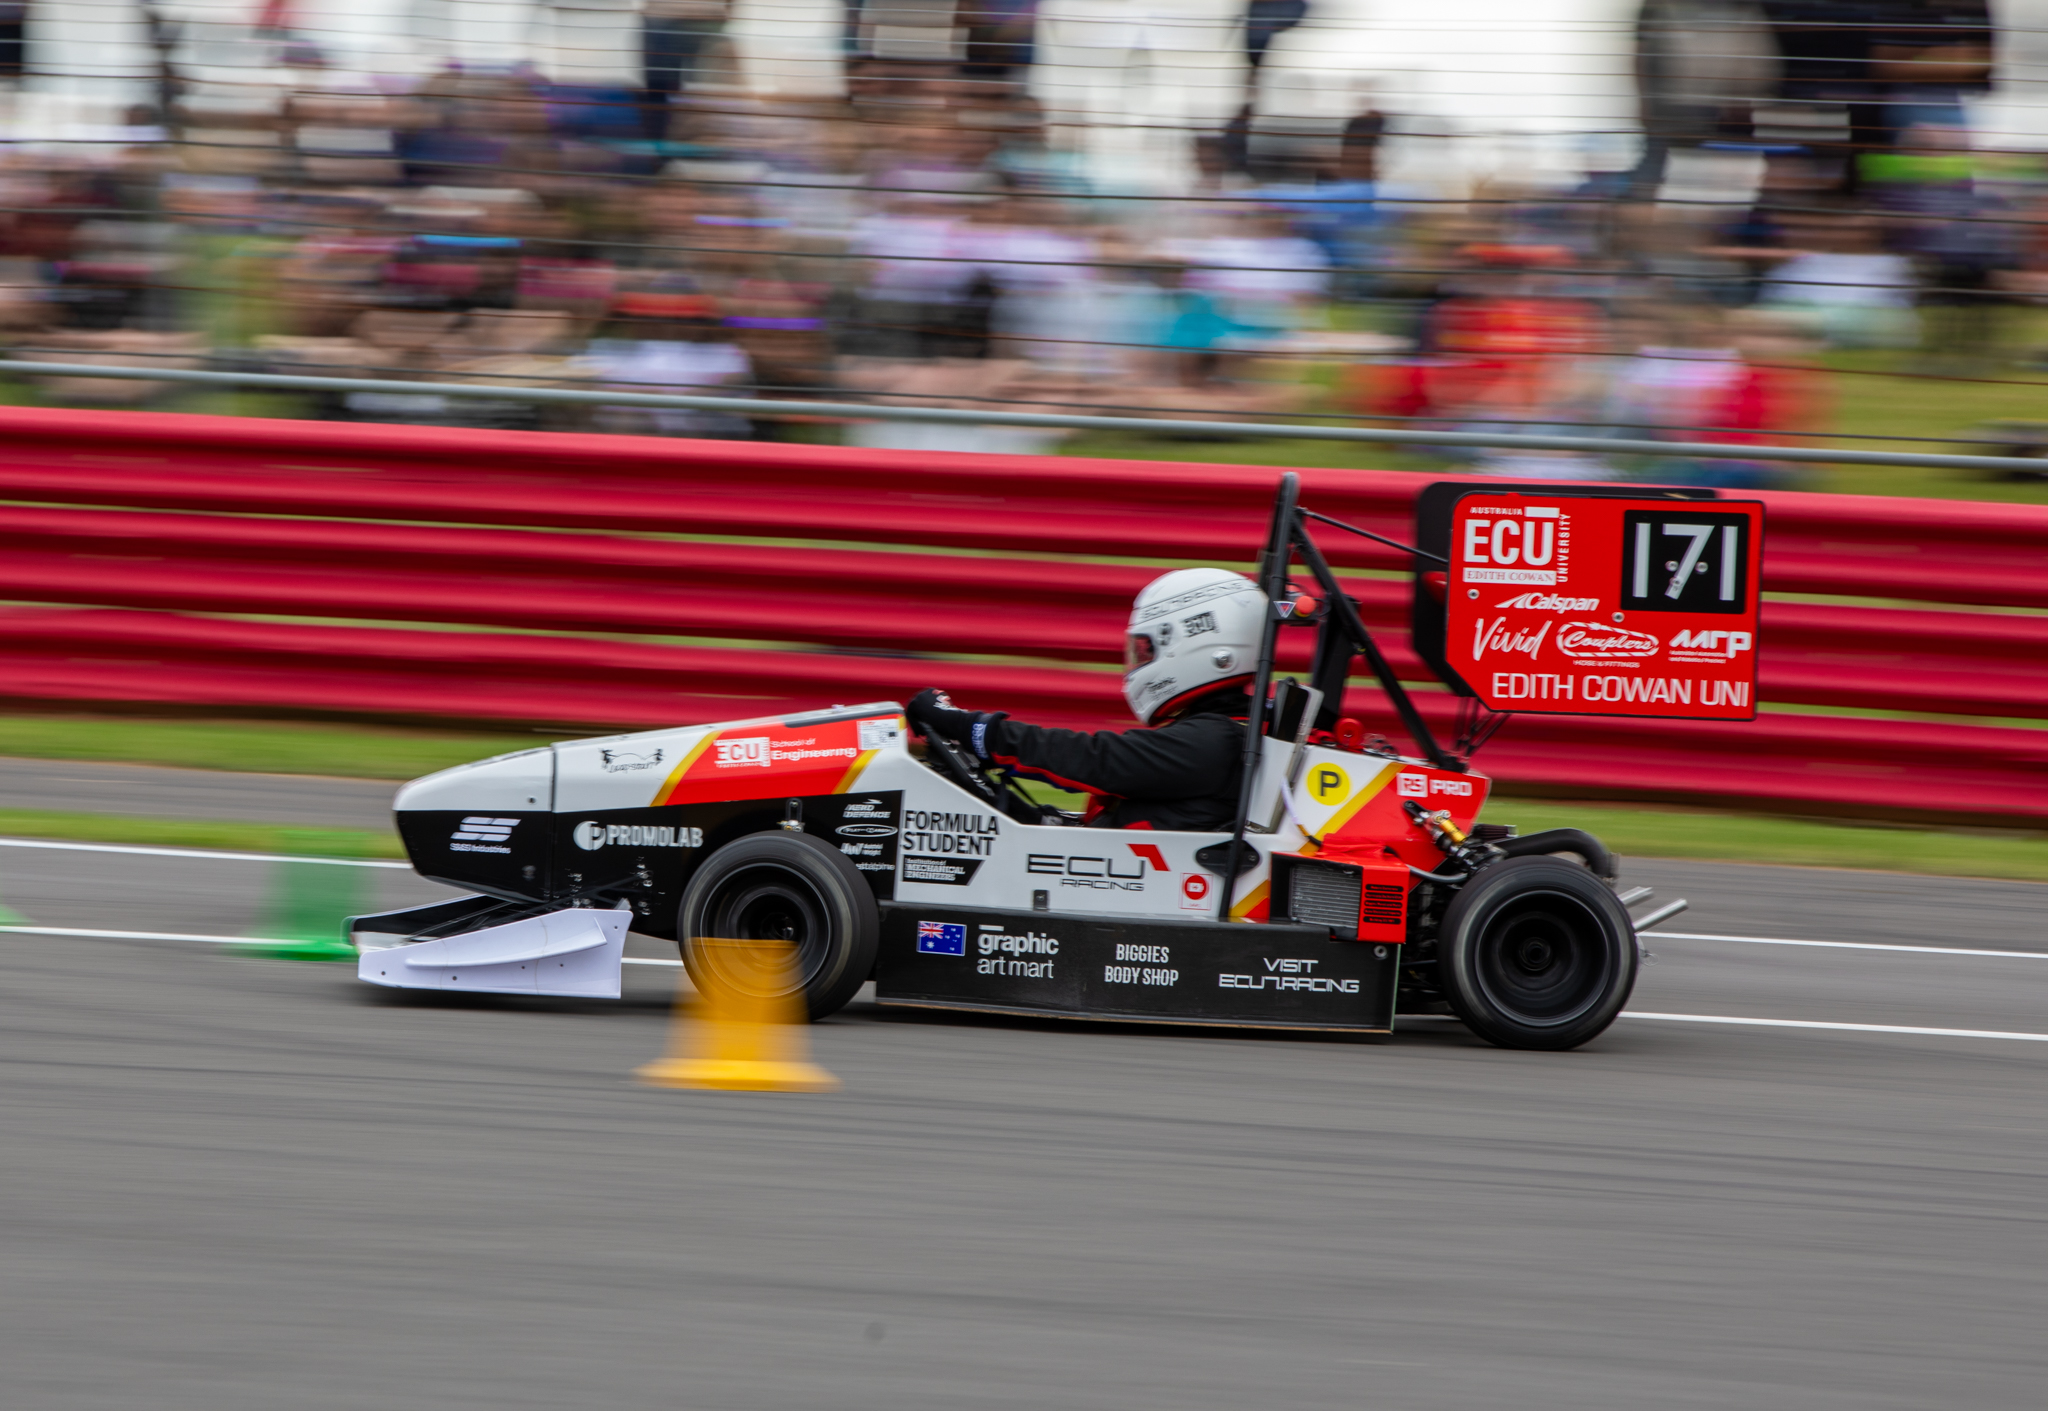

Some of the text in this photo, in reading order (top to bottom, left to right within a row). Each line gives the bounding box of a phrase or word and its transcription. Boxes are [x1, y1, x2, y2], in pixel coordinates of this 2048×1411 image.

[1470, 506, 1523, 516] AUSTRALIA
[1463, 519, 1554, 566] ECU
[1556, 513, 1571, 583] UNIVERSITY
[1633, 522, 1739, 601] 171
[1467, 570, 1554, 582] EDITH COWAN
[1524, 592, 1600, 614] Calspan
[1473, 616, 1552, 661] Vivid
[1563, 631, 1654, 651] Couplers
[1492, 672, 1749, 708] EDITH COWAN UNI
[717, 743, 760, 761] ECU
[771, 748, 857, 761] Engineering
[1317, 769, 1342, 797] P
[1400, 775, 1472, 797] RS PRO
[842, 811, 891, 819] DEFENCE
[903, 809, 1000, 836] FORMULA
[606, 824, 704, 848] PROMOLAB
[902, 831, 996, 857] STUDENT
[904, 863, 966, 875] MECHANICAL
[904, 871, 956, 881] ENGINEERS
[1027, 853, 1146, 879] ECU
[1060, 878, 1145, 892] RACING
[978, 931, 1060, 957] graphic
[1115, 943, 1170, 964] BIGGIES
[976, 956, 1055, 979] art mart
[1104, 965, 1179, 987] BODY SHOP
[1263, 957, 1319, 974] VISIT
